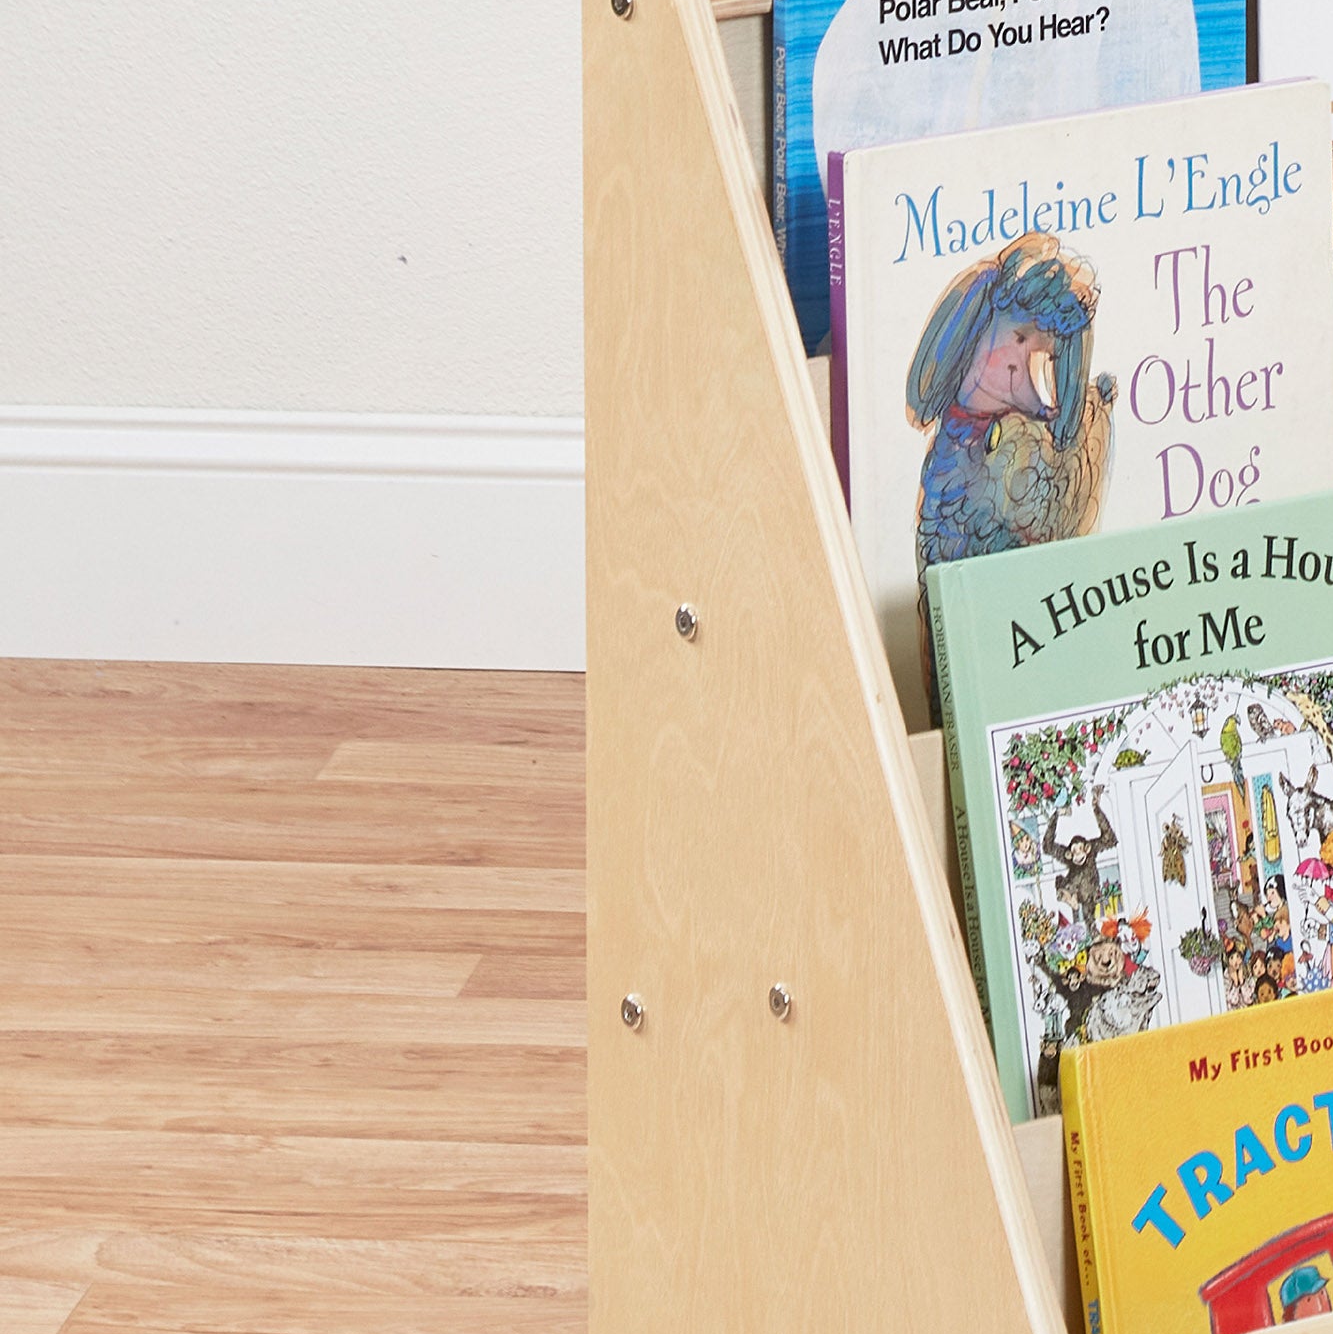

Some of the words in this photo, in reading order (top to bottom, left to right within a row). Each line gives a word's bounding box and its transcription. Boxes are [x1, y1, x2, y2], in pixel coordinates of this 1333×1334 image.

[775, 46, 786, 89] Polar
[879, 33, 942, 66] What
[949, 28, 982, 56] Do
[988, 22, 1033, 49] You
[1039, 5, 1111, 41] Hear?
[827, 198, 843, 286] L'ENGLE
[893, 181, 1118, 265] Madeleine
[1133, 141, 1303, 222] L'Engle
[1153, 243, 1255, 335] The
[1129, 337, 1284, 425] Other
[1154, 442, 1262, 521] Dog
[1010, 619, 1046, 669] A
[1041, 559, 1175, 641] House
[1183, 540, 1220, 586] Is
[1230, 547, 1252, 580] a
[1133, 619, 1192, 669] for
[1198, 605, 1267, 657] Me
[956, 825, 971, 884] House
[1188, 1056, 1222, 1083] My
[1230, 1043, 1284, 1073] First
